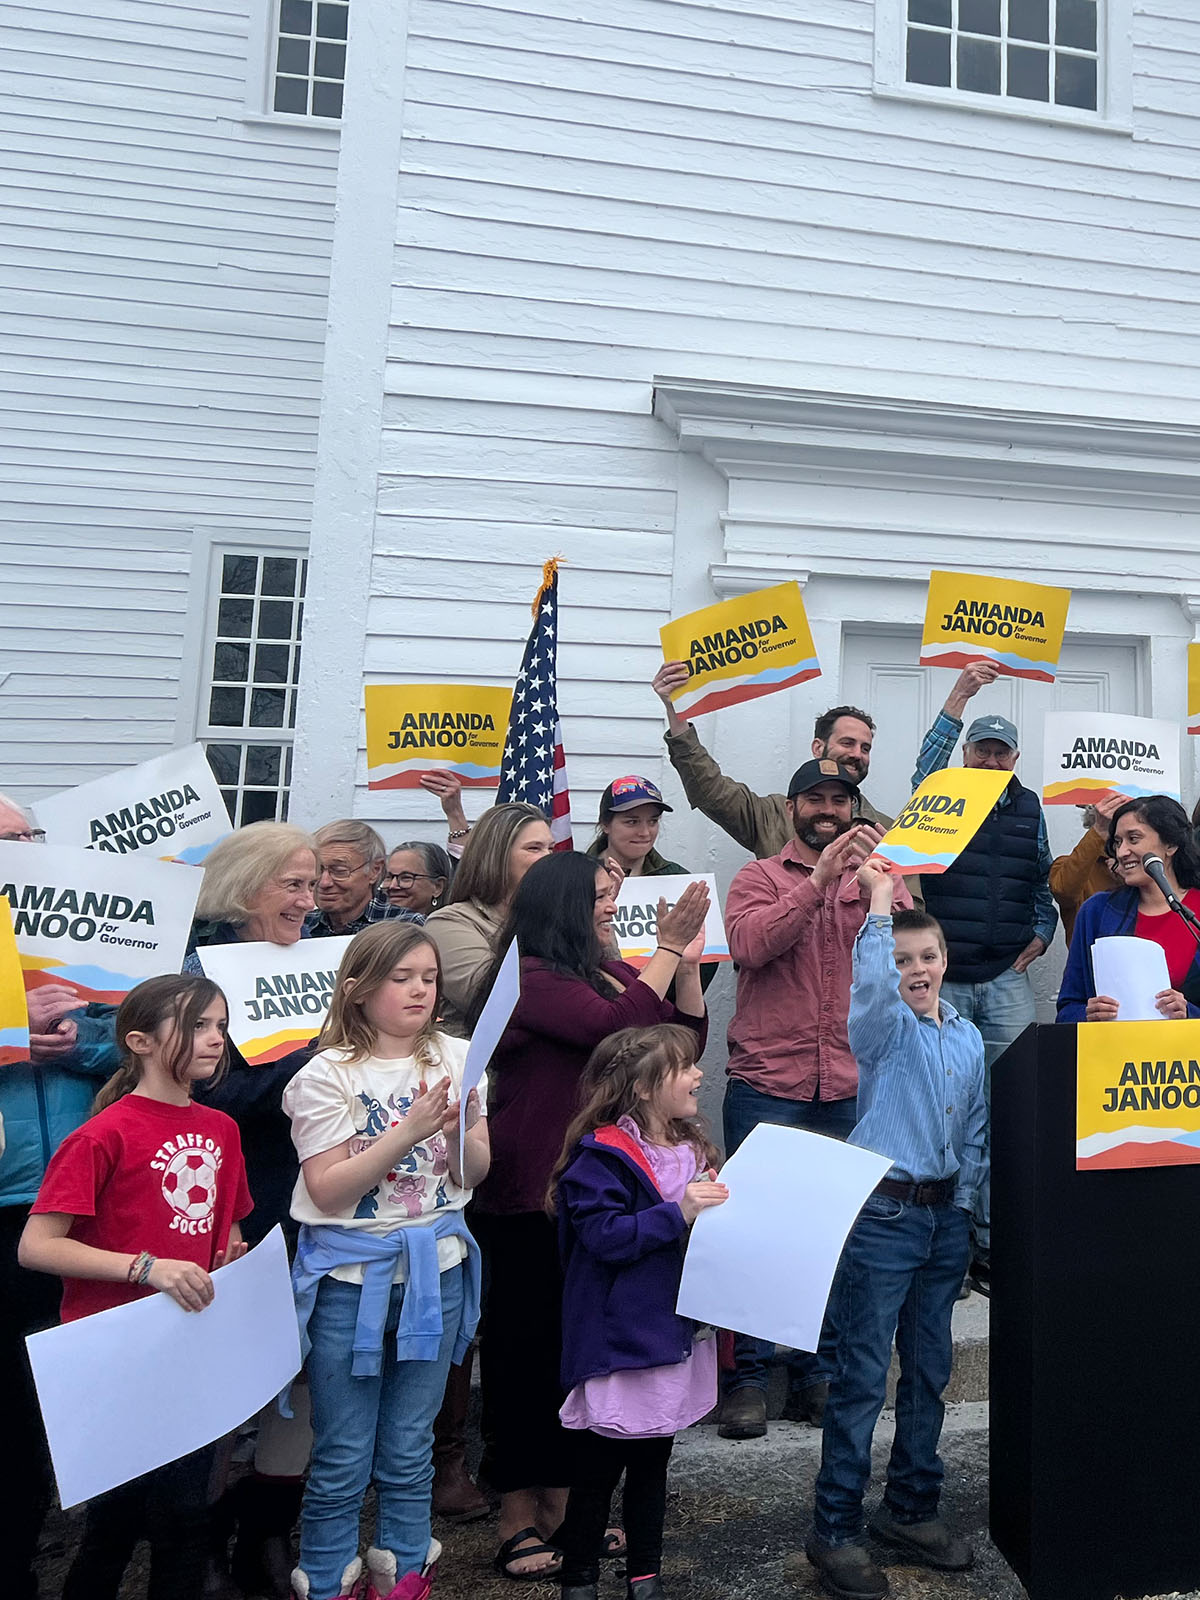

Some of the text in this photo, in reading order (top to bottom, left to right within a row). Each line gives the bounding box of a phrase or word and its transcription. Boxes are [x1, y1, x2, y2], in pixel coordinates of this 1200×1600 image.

[953, 600, 1045, 628] AMANDA
[941, 614, 1013, 638] JANOO
[1014, 625, 1025, 633] for
[690, 615, 788, 658] AMANDA
[758, 639, 770, 649] for
[762, 638, 797, 653] Governor
[1014, 633, 1047, 644] Governor
[681, 641, 759, 677] JANOO
[400, 712, 495, 731] AMANDA
[387, 730, 468, 749] JANOO
[468, 732, 478, 740] for
[469, 740, 499, 748] Governor
[1072, 737, 1160, 760] AMANDA
[1060, 753, 1131, 771] JANOO
[1133, 765, 1164, 775] Governor
[89, 783, 201, 843] AMANDA
[902, 795, 967, 817] ANDA
[174, 812, 185, 823] for
[179, 811, 212, 829] Governor
[919, 814, 935, 822] for
[84, 816, 176, 854] ANOO
[917, 823, 958, 835] Governor
[0, 883, 155, 925] AMANDA
[14, 911, 97, 942] NOO
[97, 922, 119, 933] for
[610, 921, 657, 938] NOO
[99, 933, 158, 950] Governor
[255, 970, 340, 998] AMAN
[169, 1215, 214, 1236] SOCC
